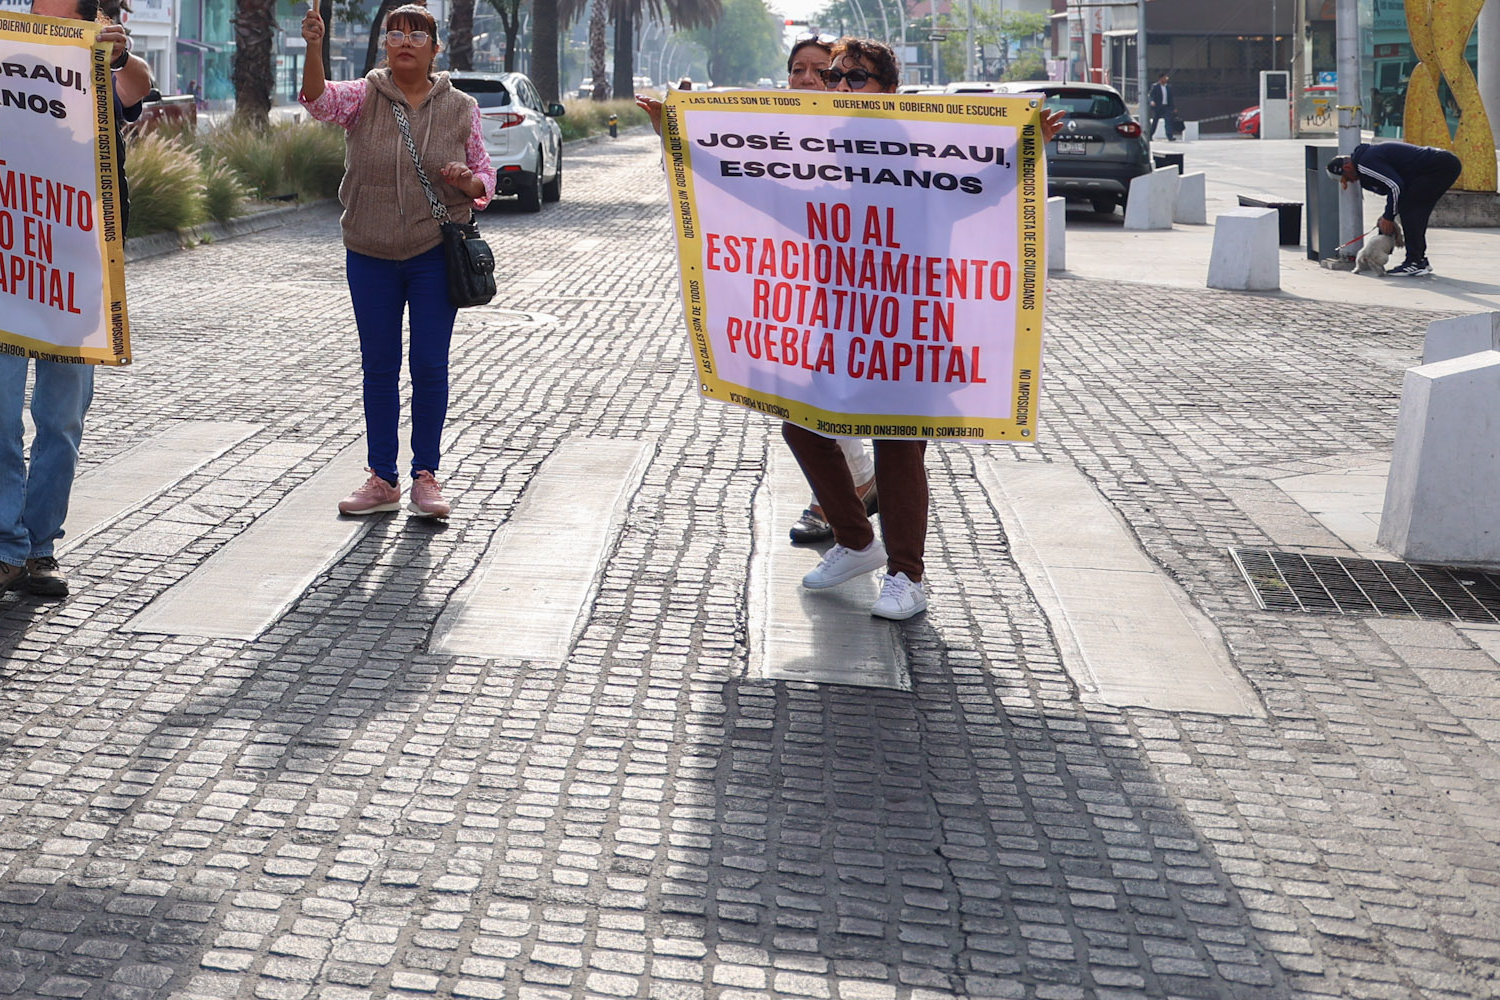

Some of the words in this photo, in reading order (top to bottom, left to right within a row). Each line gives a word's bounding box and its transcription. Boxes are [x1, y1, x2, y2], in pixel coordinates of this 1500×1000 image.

[32, 22, 48, 36] QUE
[49, 24, 84, 40] ESCUCHE
[95, 48, 106, 62] NO
[95, 64, 106, 84] MAS
[95, 84, 108, 125] NEGOCIOS
[689, 97, 706, 105] LAS
[707, 96, 739, 105] CALLES
[740, 97, 758, 105] SON
[759, 97, 771, 106] DE
[773, 97, 801, 107] TODOS
[833, 99, 880, 110] QUEREMOS
[882, 101, 895, 111] UN
[899, 101, 943, 113] GOBIERNO
[946, 103, 964, 115] QUE
[966, 105, 1008, 117] ESCUCHE
[1023, 124, 1035, 136] NO
[98, 134, 111, 160] COSTA
[670, 137, 682, 152] QUE
[697, 131, 793, 151] JOSÉ
[799, 137, 1011, 169] CHEDRAUI,
[1023, 138, 1035, 156] MAS
[100, 162, 111, 173] DE
[672, 153, 687, 188] GOBIERNO
[101, 174, 112, 190] LOS
[719, 160, 983, 195] ESCUCHANOS
[1023, 158, 1036, 196] NEGOCIOS
[678, 190, 688, 200] UN
[101, 191, 116, 242] CIUDADANOS
[680, 201, 694, 239] QUEREMOS
[806, 201, 850, 243] NO
[862, 205, 900, 249] AL
[1024, 205, 1036, 230] COSTA
[23, 215, 53, 264] EN
[1024, 232, 1036, 242] DE
[1024, 243, 1036, 258] LOS
[705, 232, 1012, 302] ESTACIONAMIENTO
[689, 280, 700, 305] TODOS
[1022, 259, 1036, 311] CIUDADANOS
[110, 301, 121, 312] NO
[691, 305, 702, 316] DE
[753, 278, 899, 339] ROTATIVO
[912, 299, 955, 343] EN
[692, 316, 703, 333] SON
[111, 313, 124, 355] IMPOSICION
[696, 333, 708, 360] CALLES
[726, 316, 835, 374] PUEBLA
[847, 336, 987, 384] CAPITAL
[703, 359, 712, 374] LAS
[1019, 369, 1031, 380] NO
[758, 401, 790, 419] CONSULTA
[1016, 381, 1030, 426] IMPOSICION
[816, 418, 853, 435] ESCUCHE
[854, 424, 871, 436] QUE
[873, 425, 917, 437] GOBIERNO
[921, 426, 934, 437] UN
[936, 426, 984, 438] QUEREMOS
